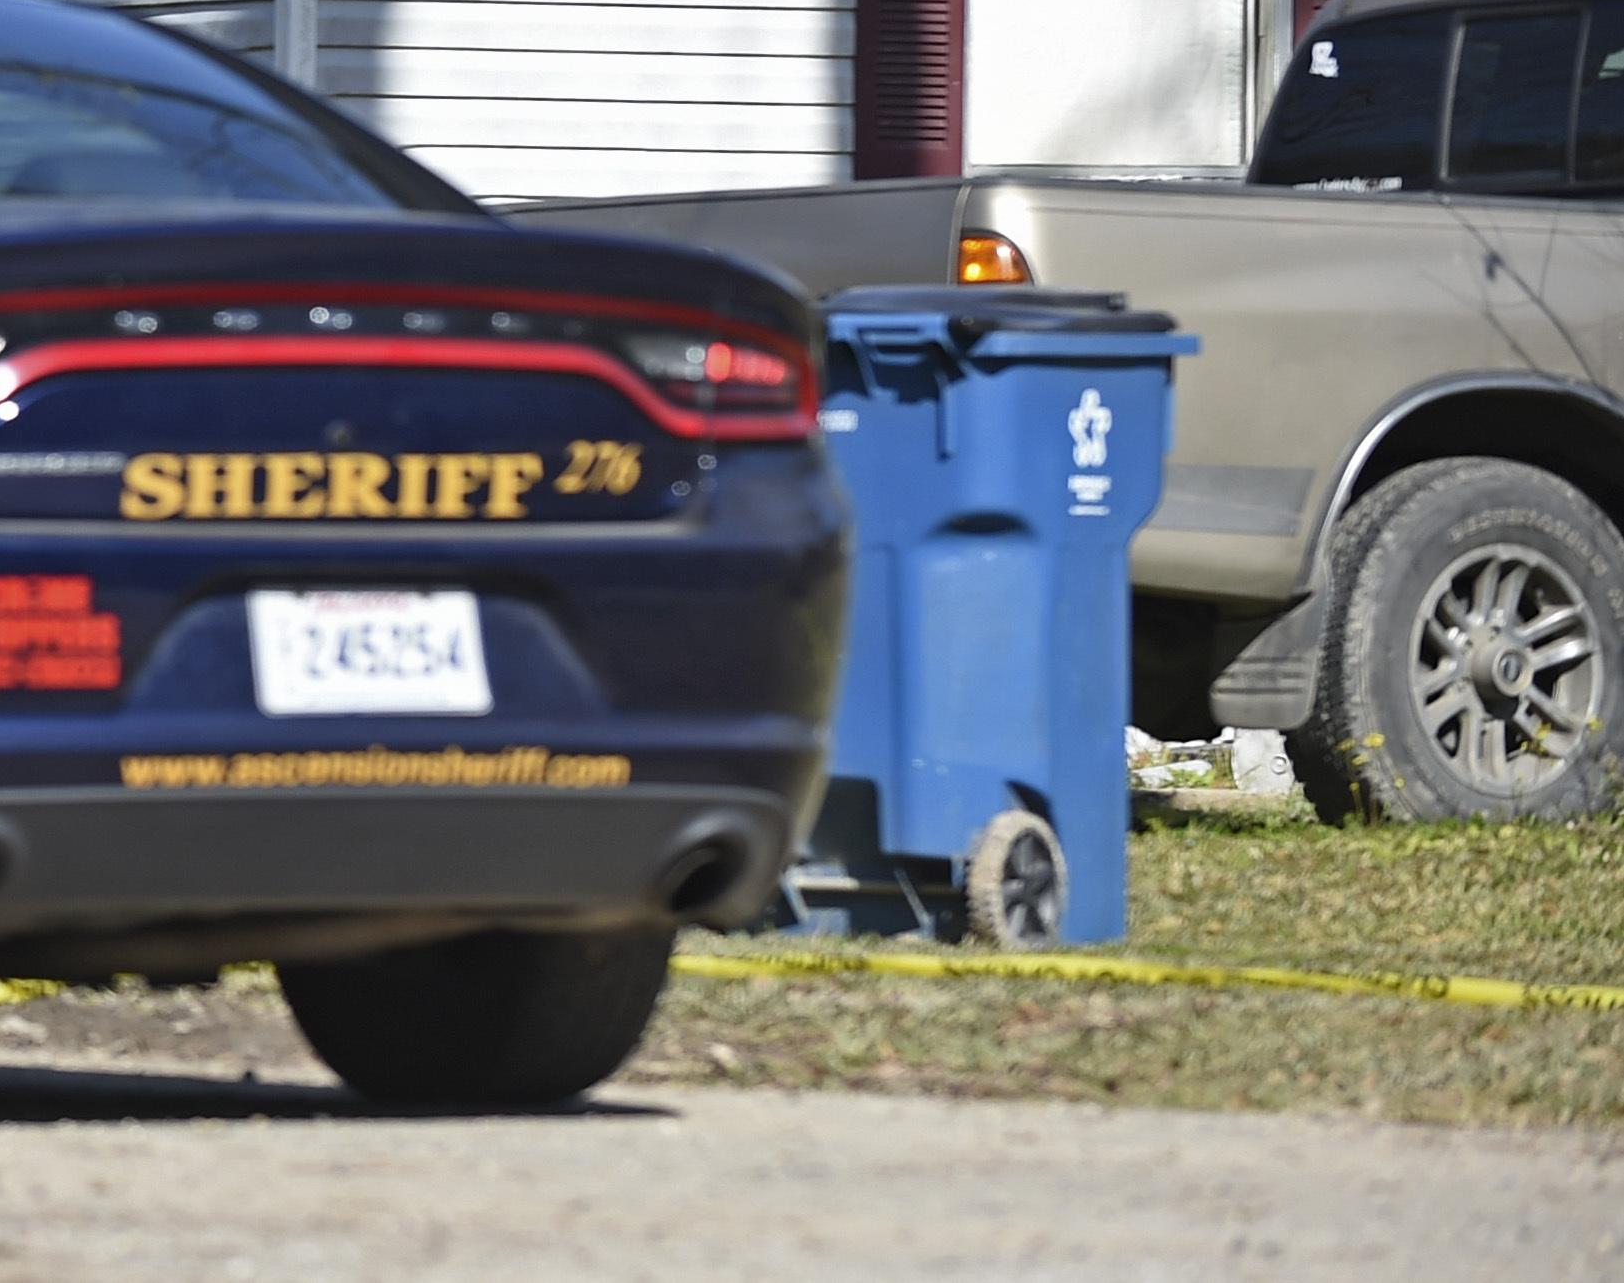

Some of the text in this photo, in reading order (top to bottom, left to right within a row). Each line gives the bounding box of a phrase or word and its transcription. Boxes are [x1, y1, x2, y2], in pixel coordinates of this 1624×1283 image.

[120, 439, 644, 519] SHERIFF 276
[302, 621, 467, 680] 245254
